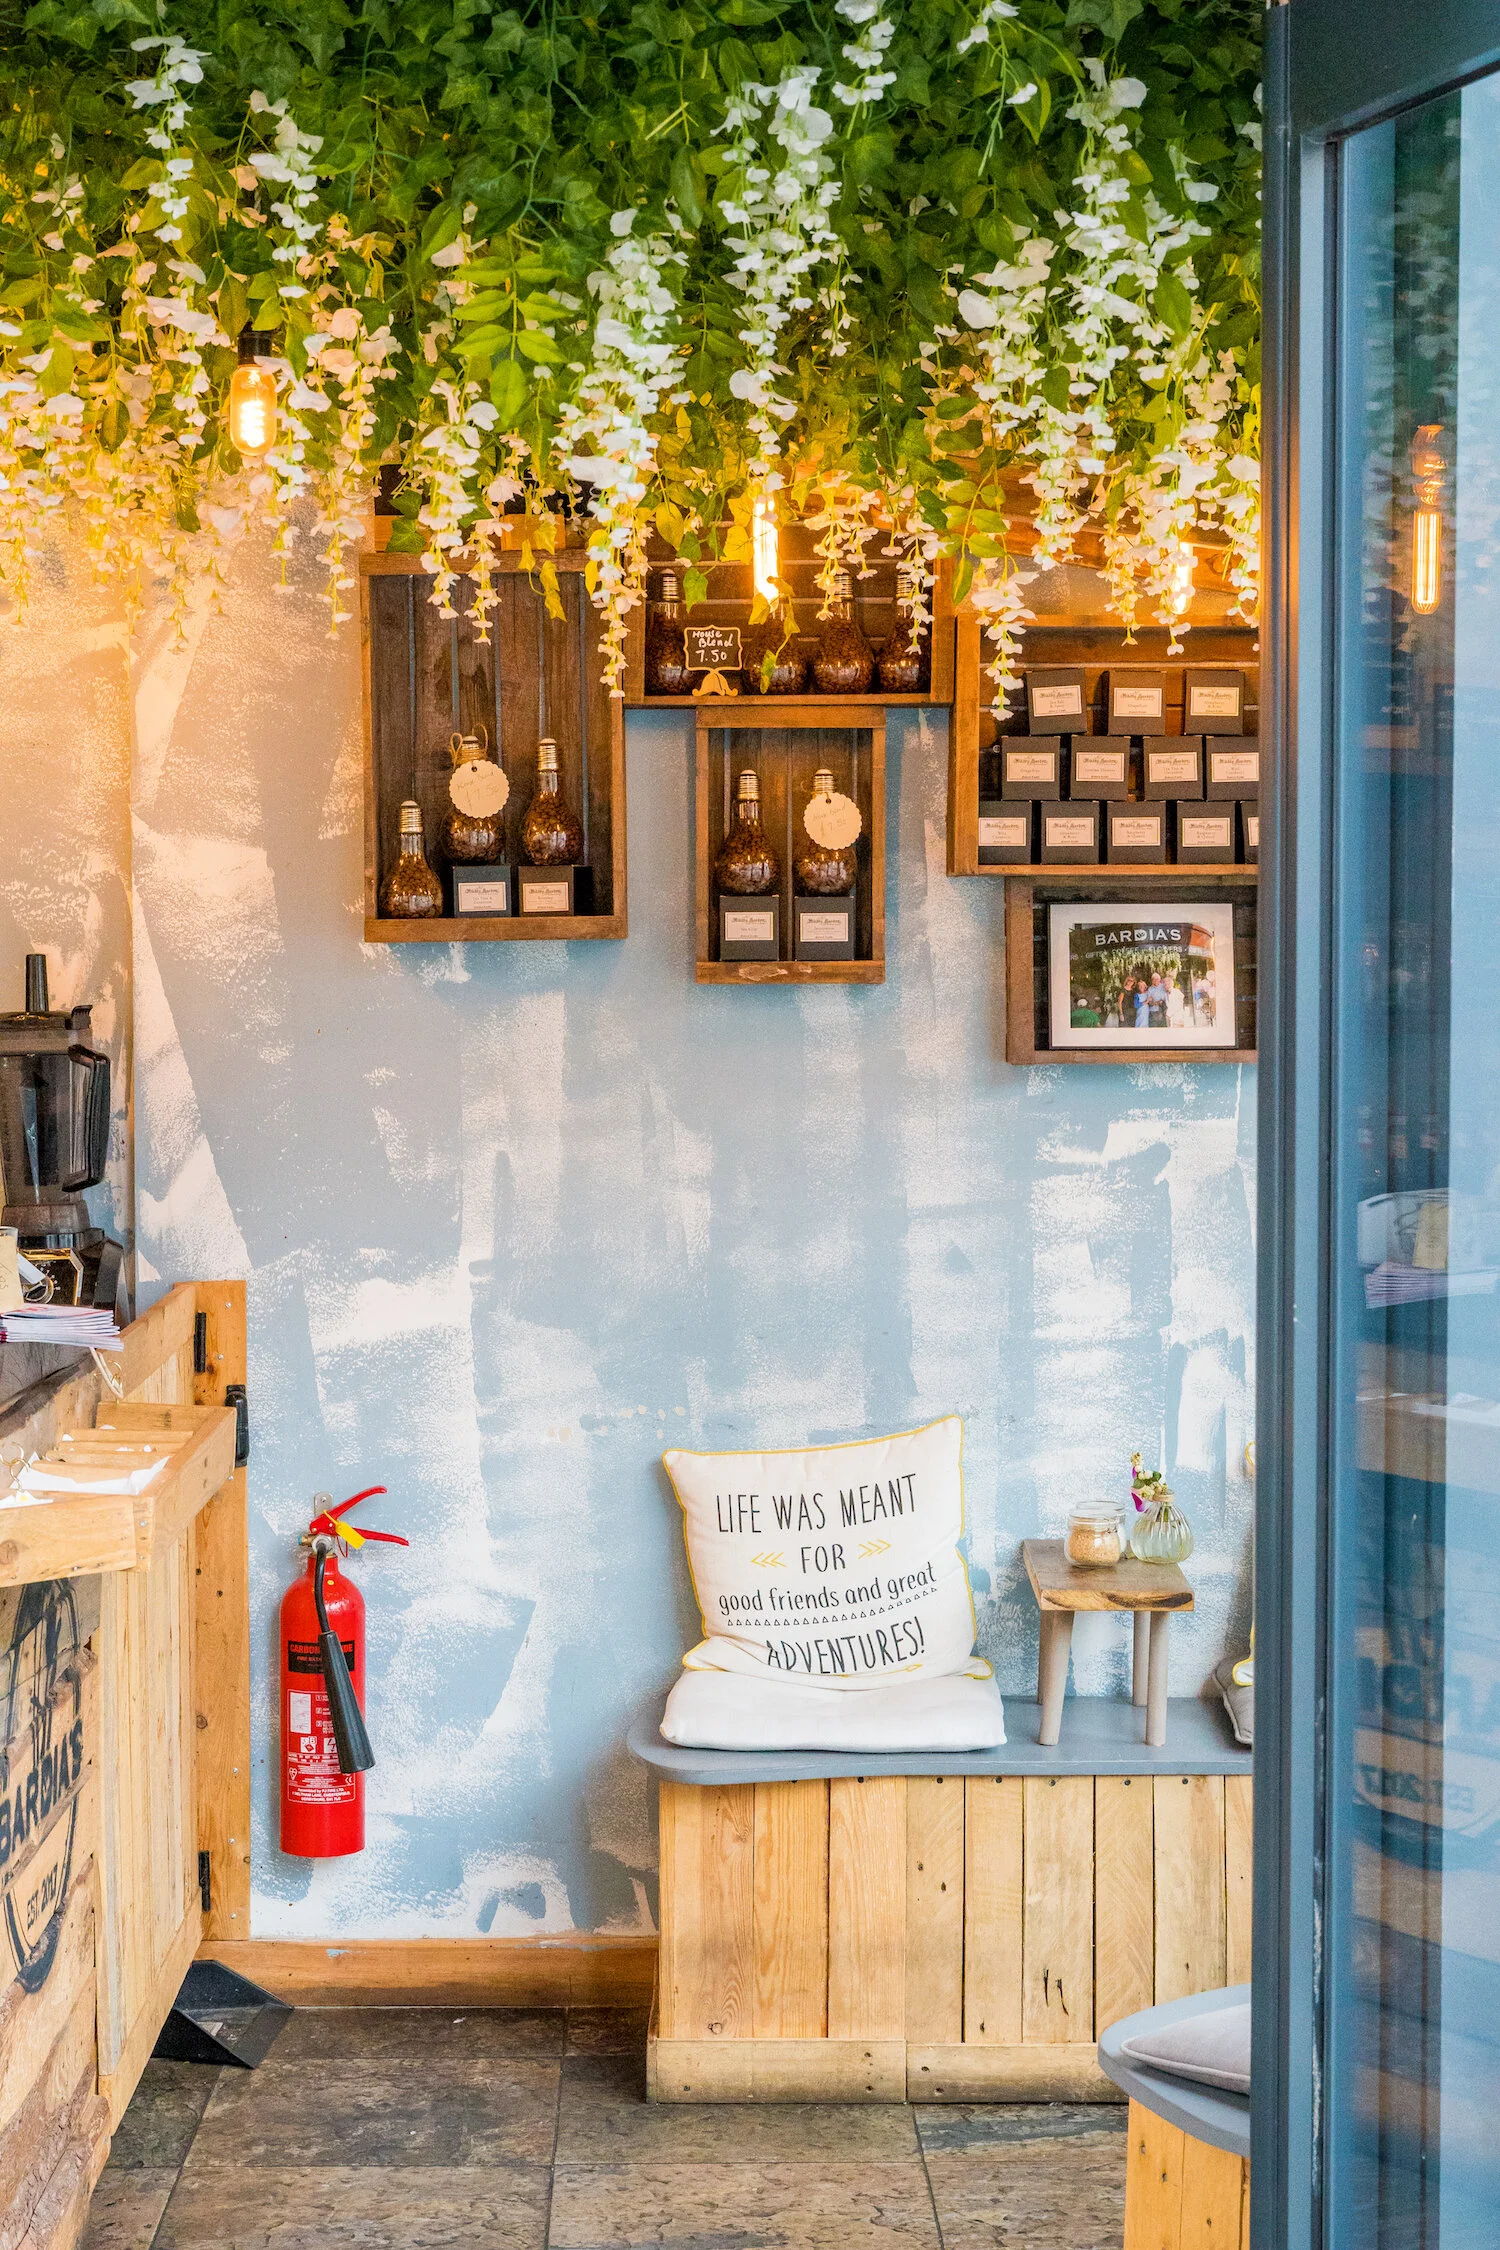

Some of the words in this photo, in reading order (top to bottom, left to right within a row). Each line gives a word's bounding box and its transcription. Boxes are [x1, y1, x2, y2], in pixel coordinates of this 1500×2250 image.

[692, 630, 722, 638] House
[698, 633, 733, 648] Blend
[695, 649, 727, 663] 7.50
[1094, 928, 1182, 946] BARDIA'S
[716, 1494, 762, 1533] LIFE
[772, 1492, 826, 1531] WAS
[839, 1473, 916, 1528] MEANT
[800, 1543, 846, 1574] FOR
[719, 1589, 763, 1616] good
[769, 1586, 840, 1612] friends
[845, 1577, 882, 1605] and
[887, 1561, 937, 1600] great
[766, 1616, 926, 1675] ADVENTURES!
[41, 1862, 58, 1912] 2017
